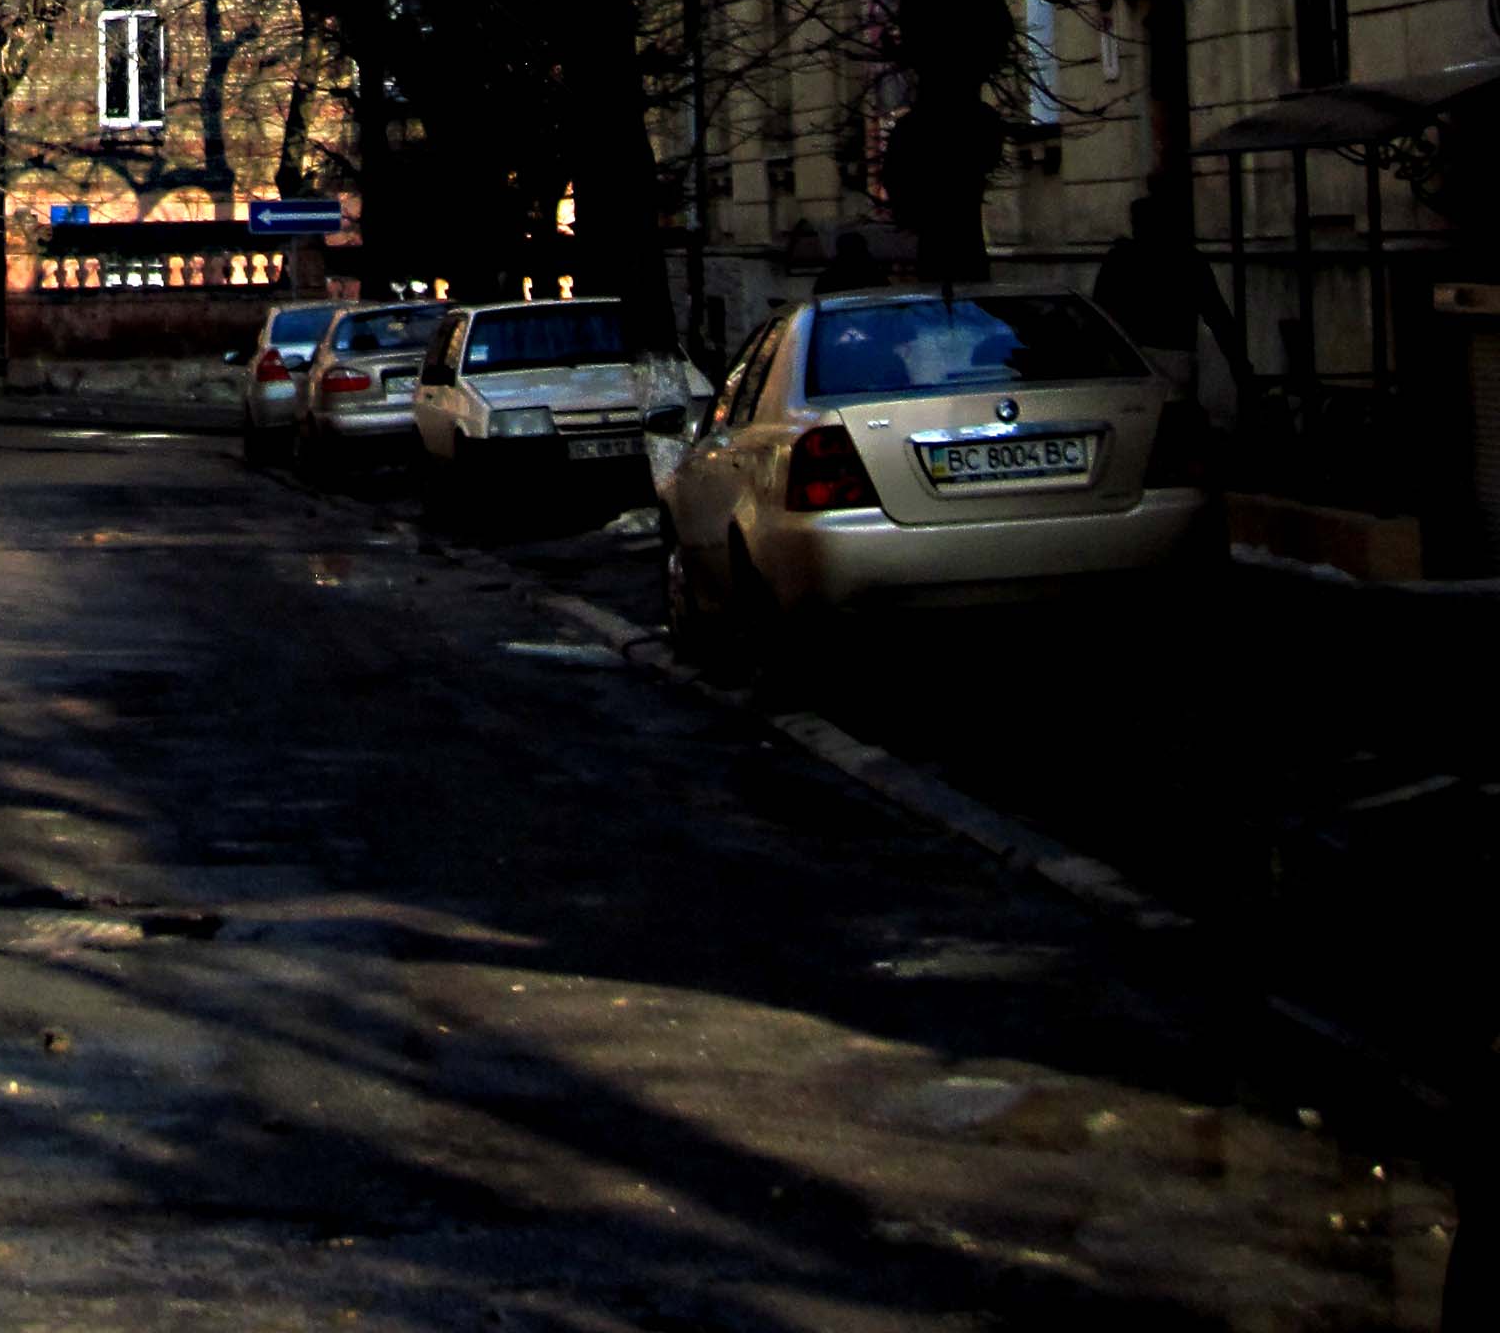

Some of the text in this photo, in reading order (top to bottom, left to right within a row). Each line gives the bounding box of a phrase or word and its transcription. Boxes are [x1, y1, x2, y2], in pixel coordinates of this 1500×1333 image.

[948, 441, 1079, 472] BC 8004 BC
